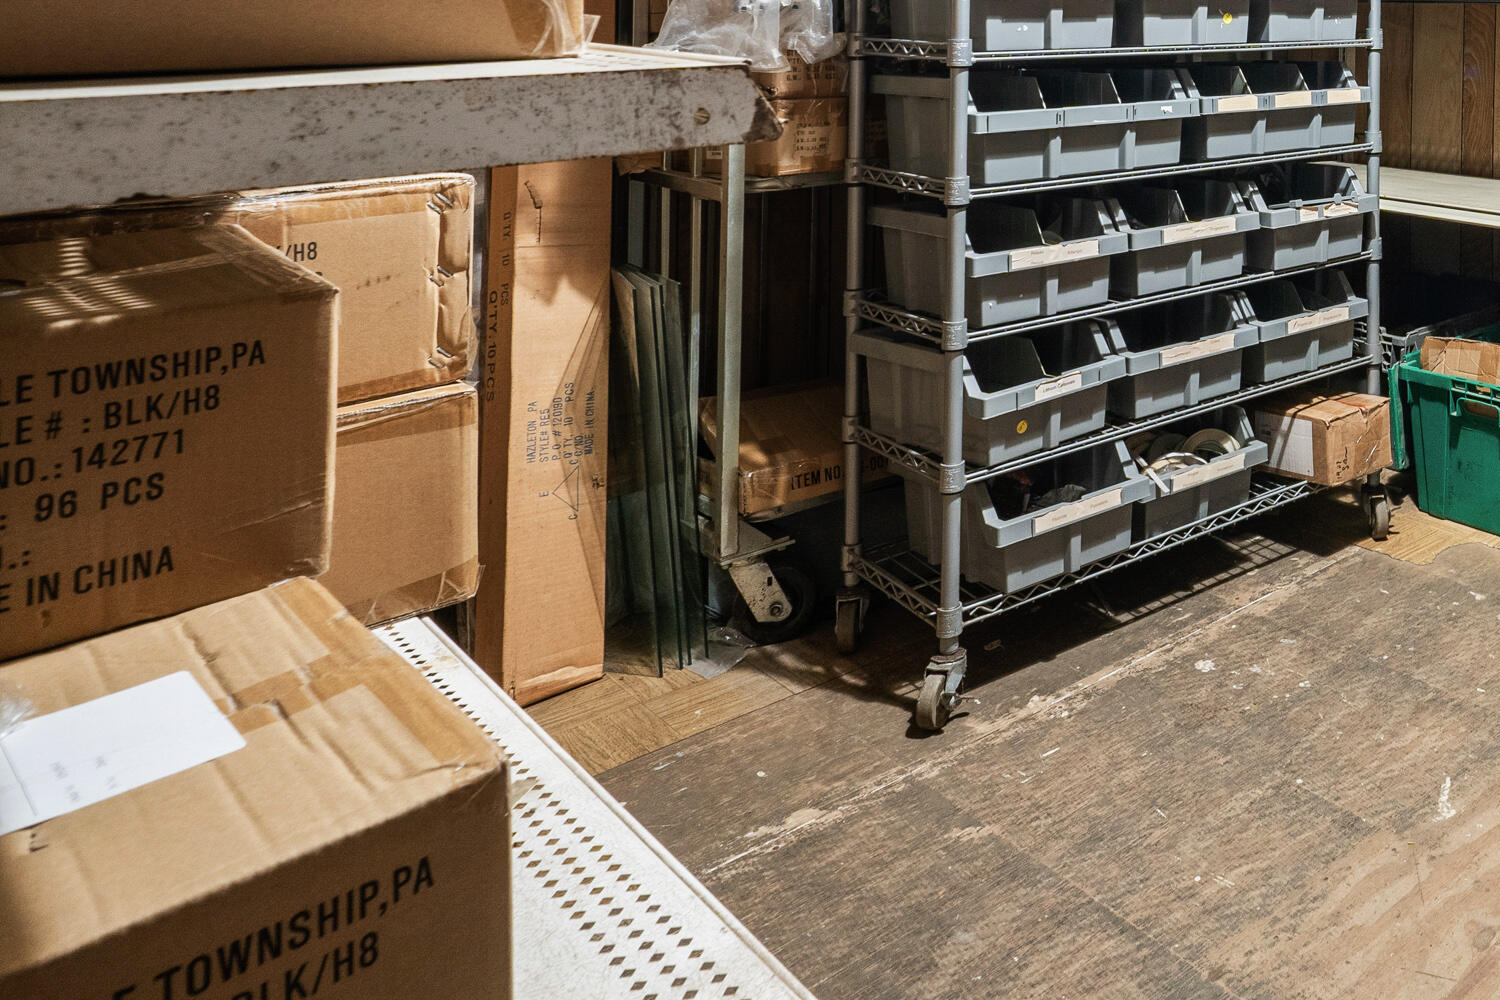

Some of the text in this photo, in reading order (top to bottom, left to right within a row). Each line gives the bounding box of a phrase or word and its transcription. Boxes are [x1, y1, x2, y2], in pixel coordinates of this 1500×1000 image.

[500, 282, 509, 306] PCS
[48, 339, 266, 399] TOWNSHIP,PA
[103, 384, 221, 431] BLK/H8
[539, 408, 550, 427] RE5
[563, 382, 575, 427] 10 PCS
[72, 428, 185, 475] 142771
[526, 401, 537, 464] HAZLETON PA
[34, 472, 166, 523] 96 PCS
[791, 469, 821, 491] ITEM
[25, 571, 60, 607] IN
[73, 545, 175, 595] CHINA
[153, 855, 436, 1000] TOWNSHIP,PA
